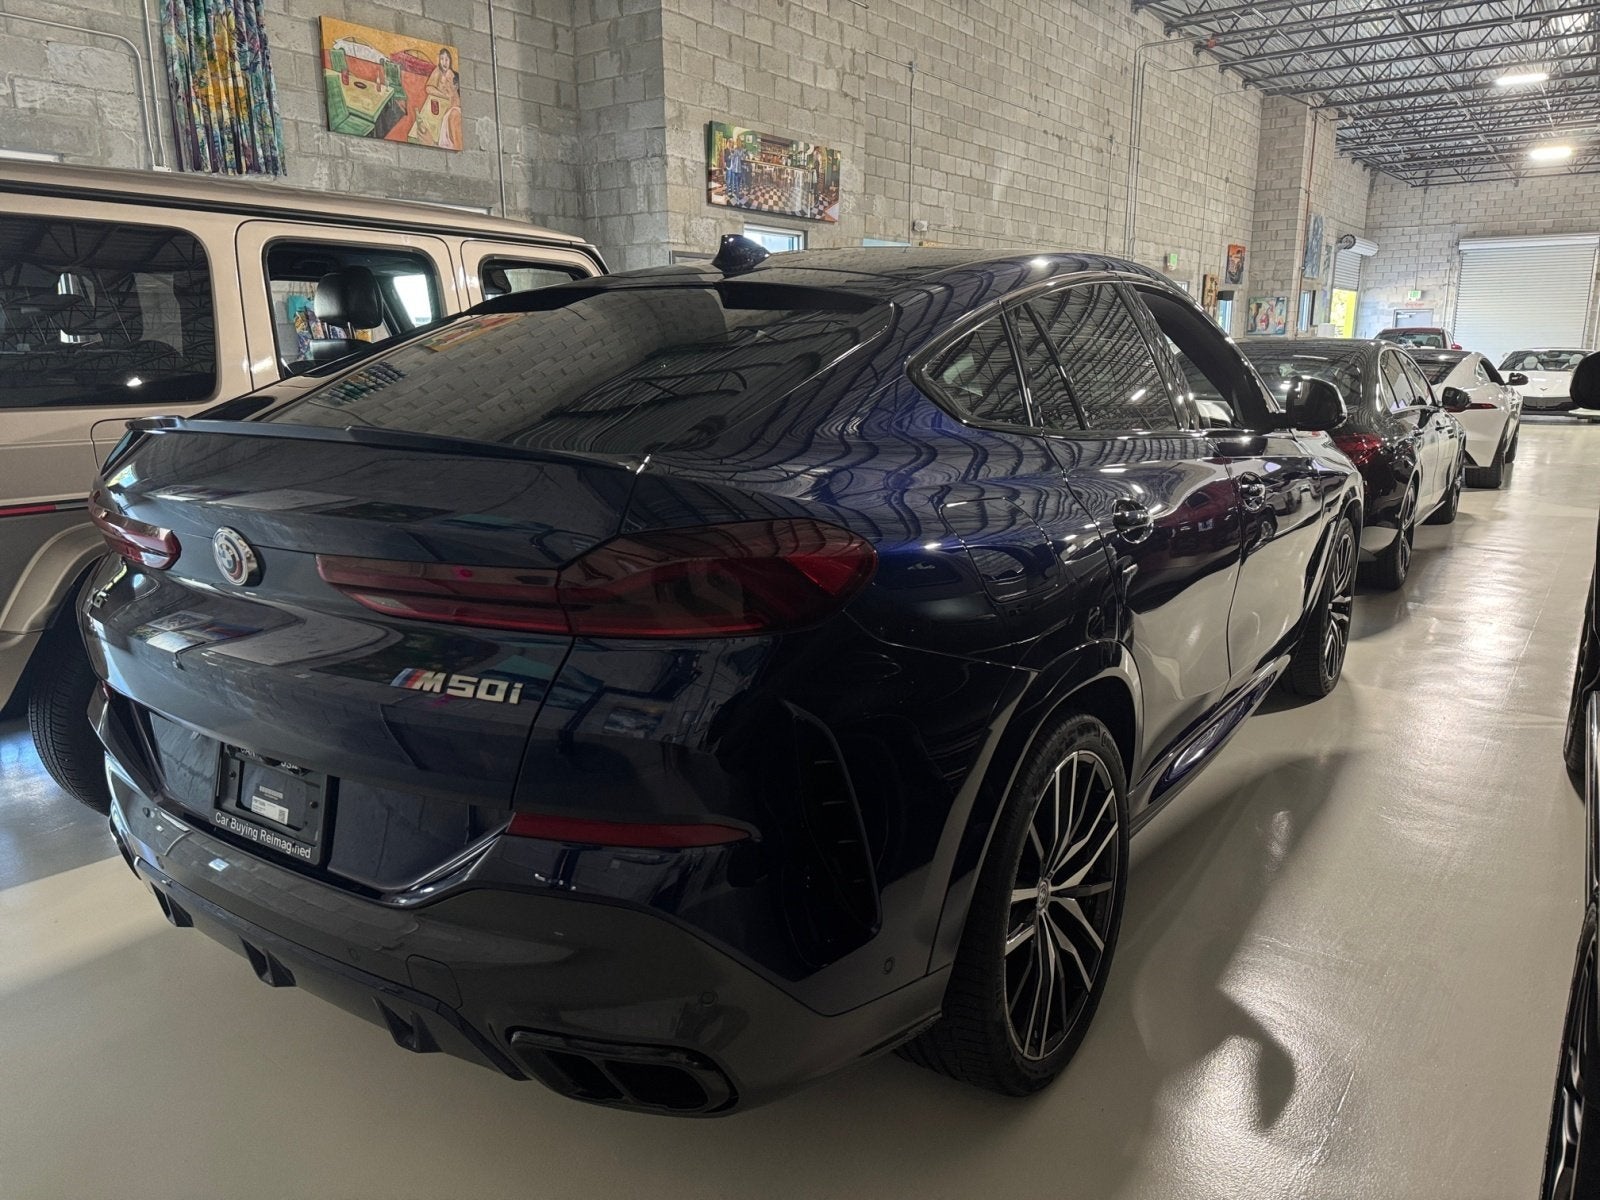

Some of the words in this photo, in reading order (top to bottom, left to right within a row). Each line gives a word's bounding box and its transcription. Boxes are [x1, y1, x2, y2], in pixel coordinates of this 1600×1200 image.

[408, 669, 524, 705] M50i
[215, 811, 230, 827] Car
[230, 816, 258, 841] Buying
